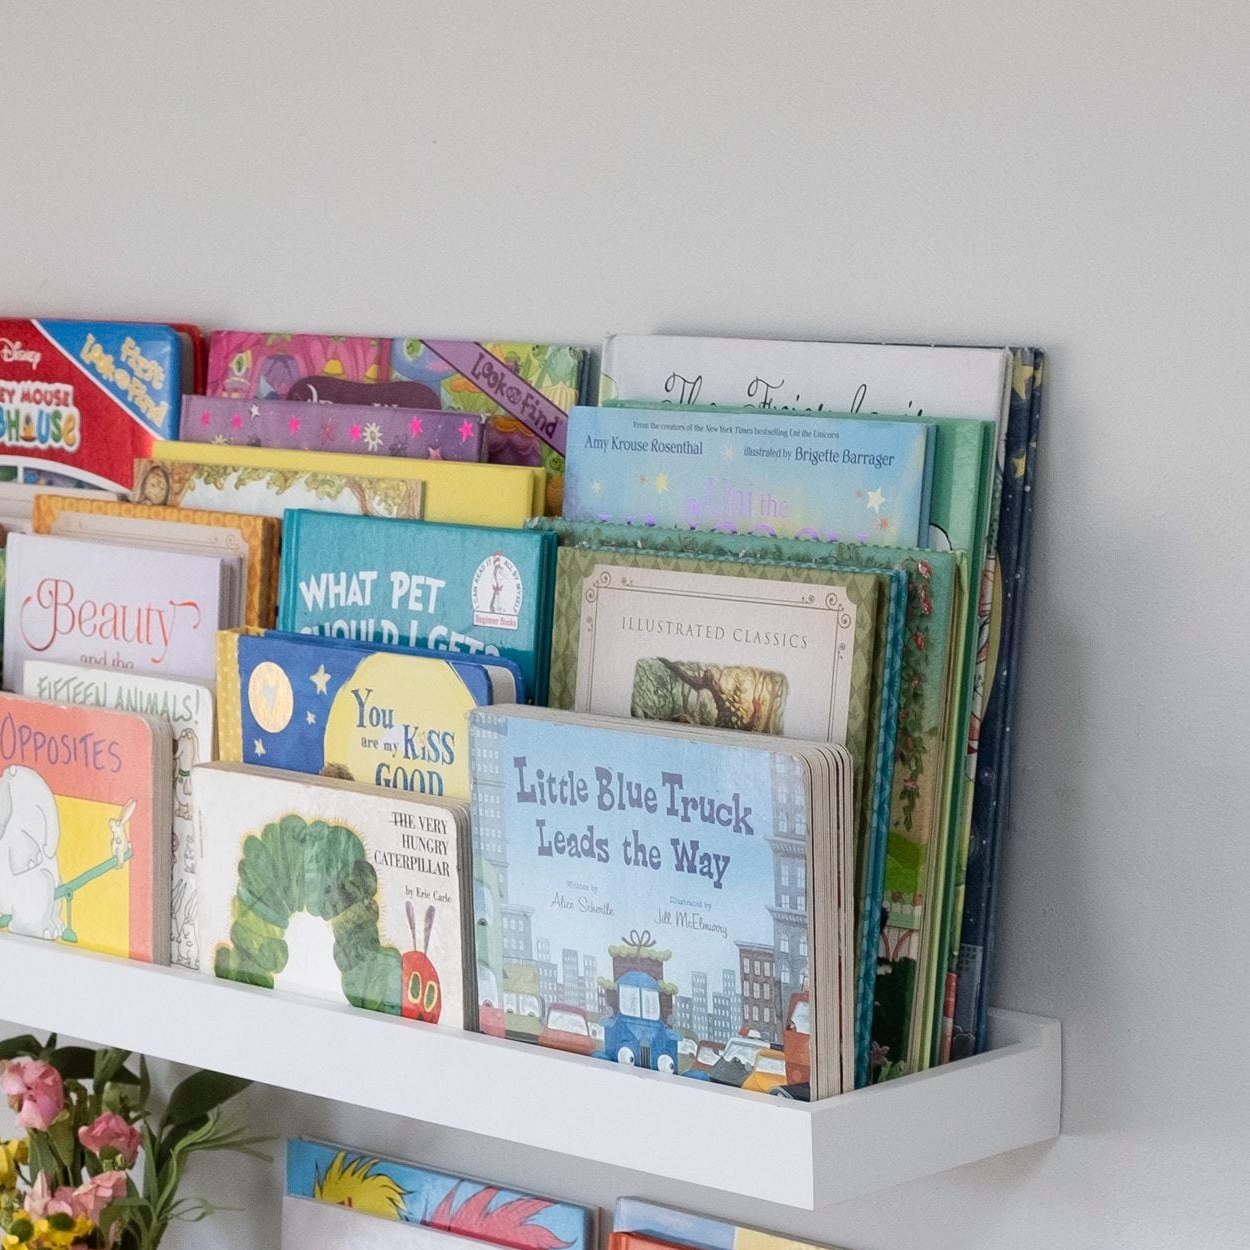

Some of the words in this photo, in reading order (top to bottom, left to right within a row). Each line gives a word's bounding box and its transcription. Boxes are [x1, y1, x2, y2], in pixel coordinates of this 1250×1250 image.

[20, 387, 71, 408] MOUSE
[471, 352, 507, 396] Look
[520, 392, 561, 440] Find
[633, 421, 650, 430] From
[650, 421, 660, 430] the
[660, 422, 686, 431] creators
[694, 424, 704, 432] the
[705, 425, 719, 433] New
[719, 425, 733, 433] York
[754, 427, 788, 438] bestselling
[801, 429, 812, 438] the
[813, 429, 840, 439] Unicorn
[584, 434, 608, 453] Amy
[611, 436, 649, 452] Krouse
[650, 438, 703, 455] Rosenthal
[743, 446, 781, 458] illustrated
[782, 448, 792, 460] by
[795, 446, 840, 466] Brigette
[842, 448, 895, 470] Barrager
[760, 495, 790, 519] the
[299, 571, 378, 613] WHAT
[390, 571, 446, 614] PET
[20, 578, 200, 663] Beauty
[622, 616, 725, 640] ILLUSTRATED
[732, 628, 808, 649] CLASSICS
[80, 651, 107, 666] and
[115, 686, 200, 724] ANIMALS!
[351, 688, 394, 729] You
[0, 712, 123, 773] OPPOSITES
[361, 737, 379, 749] are
[383, 742, 399, 758] my
[375, 762, 444, 797] GOOD
[513, 756, 589, 806] Little
[595, 766, 658, 814] Blue
[661, 771, 754, 836] Truck
[391, 811, 416, 829] THE
[418, 815, 448, 835] VERY
[402, 833, 449, 856] HUNGRY
[535, 819, 610, 864] Leads
[622, 829, 662, 871] the
[670, 837, 731, 890] Way
[374, 849, 450, 877] CATERPILLAR
[405, 884, 413, 899] by
[416, 887, 431, 899] Eric
[433, 890, 451, 902] Carle
[591, 884, 599, 895] by
[550, 892, 575, 910] Alice
[578, 896, 615, 917] Schertle
[653, 905, 672, 925] Jill
[704, 901, 712, 912] by
